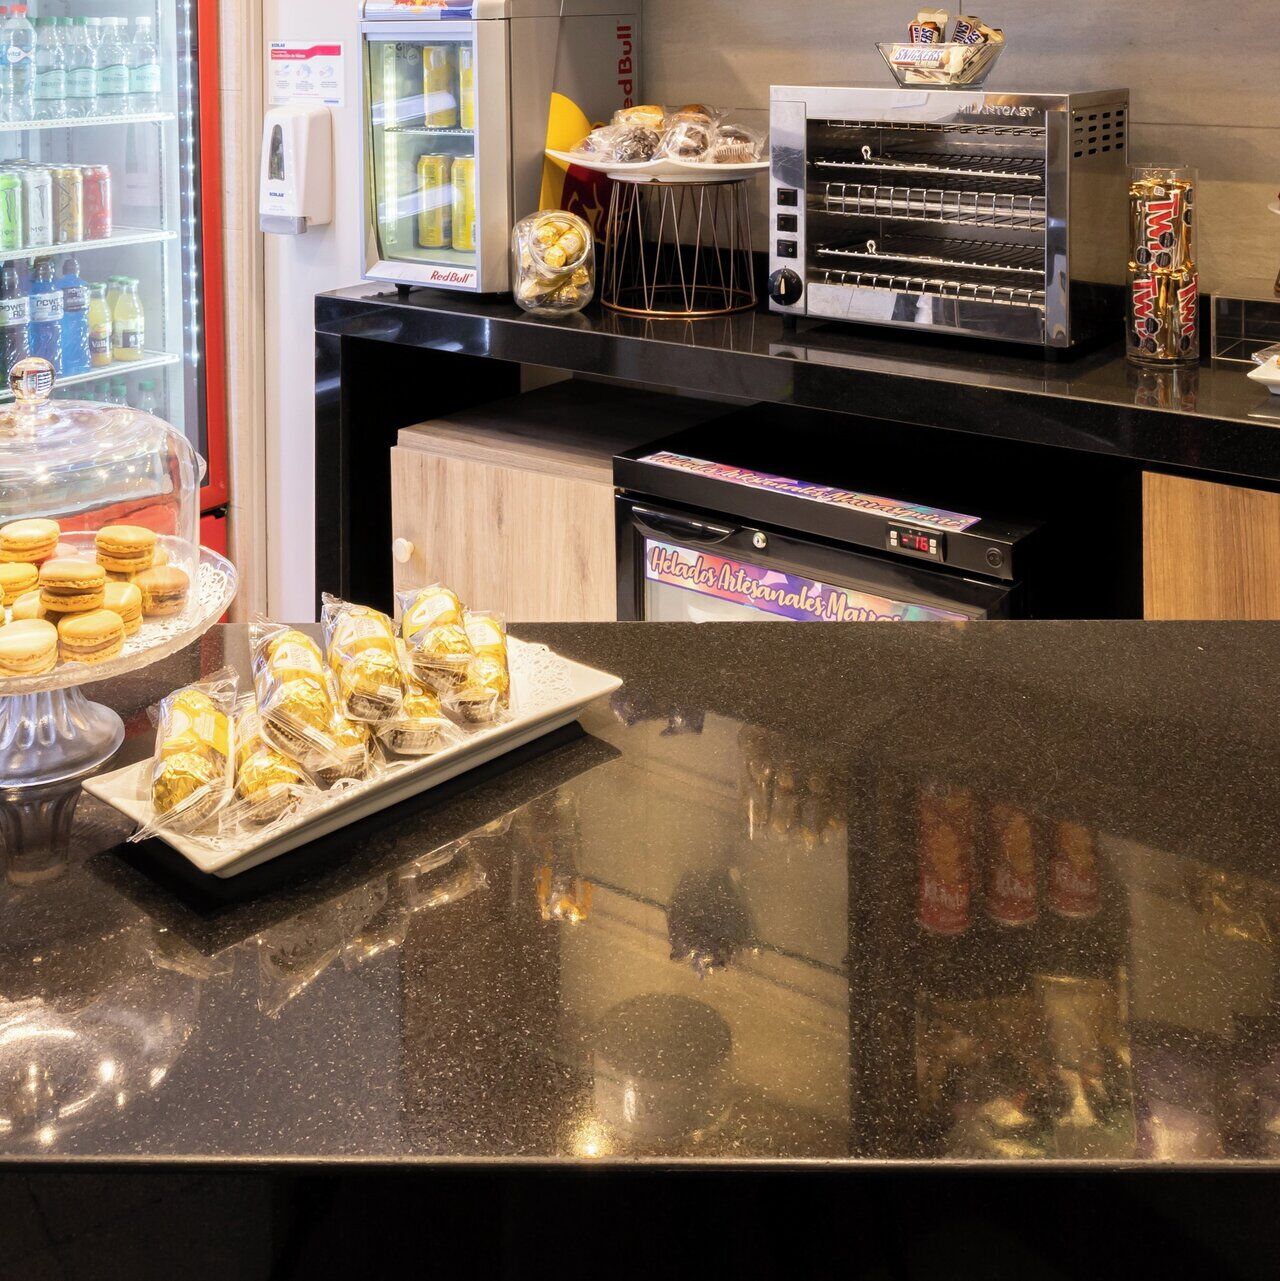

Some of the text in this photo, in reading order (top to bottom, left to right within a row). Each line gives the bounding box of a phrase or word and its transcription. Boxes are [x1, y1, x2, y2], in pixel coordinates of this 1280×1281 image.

[616, 25, 633, 109] ed Bull
[894, 48, 945, 62] SNICKERS
[1145, 190, 1181, 272] TWI
[430, 270, 470, 284] Red Bull
[1133, 272, 1159, 339] TWI
[651, 546, 717, 586] Helados
[717, 563, 825, 616] Artesanales
